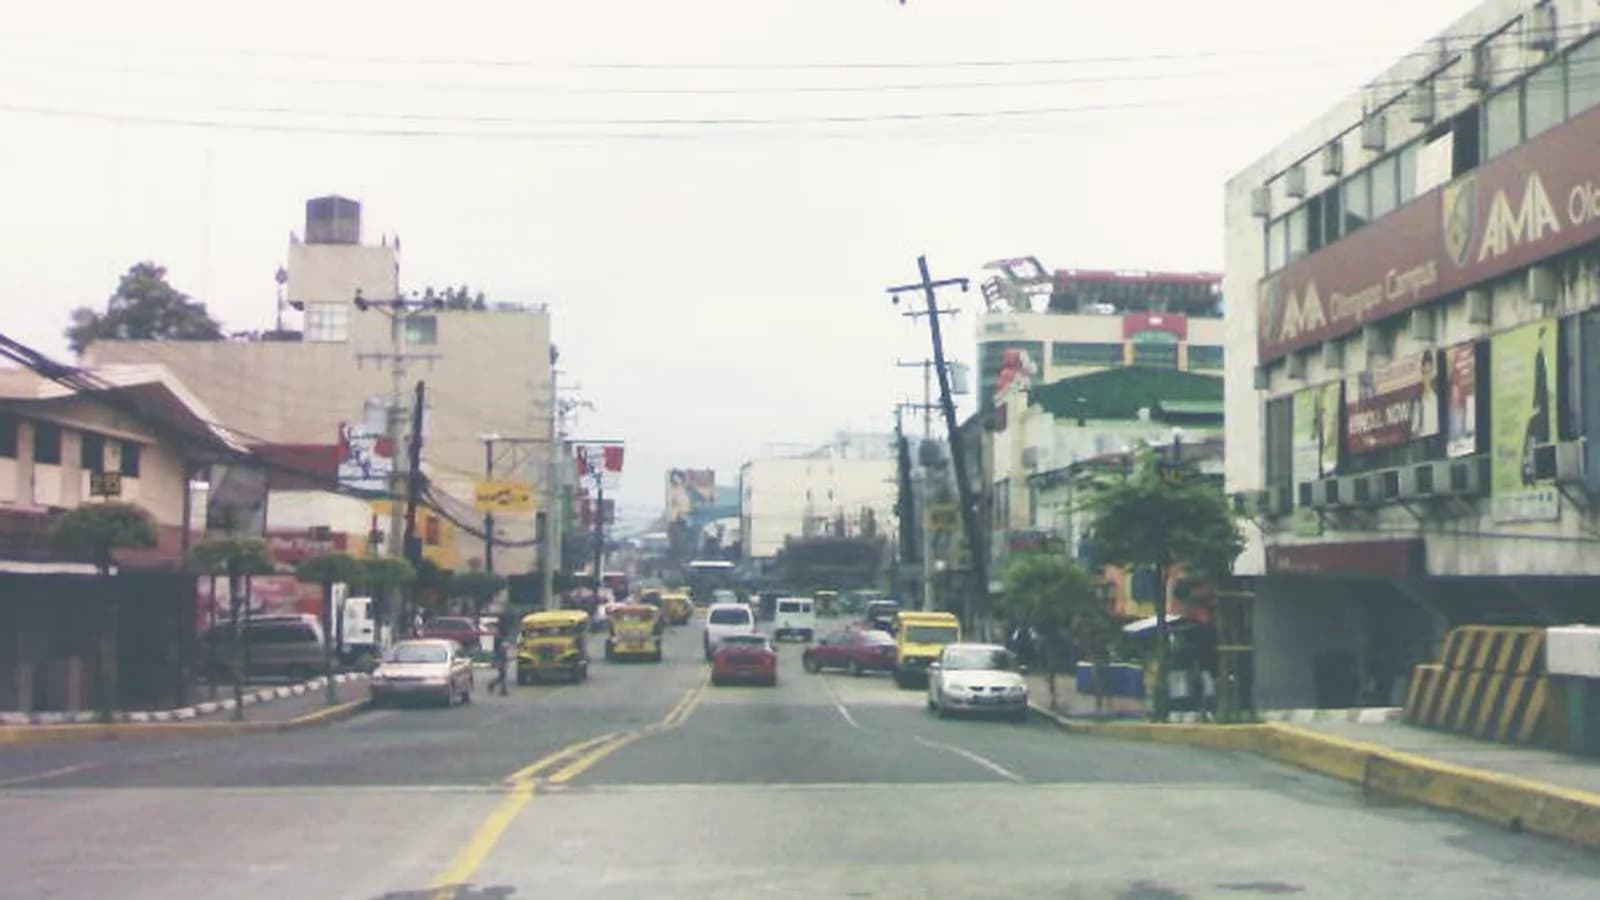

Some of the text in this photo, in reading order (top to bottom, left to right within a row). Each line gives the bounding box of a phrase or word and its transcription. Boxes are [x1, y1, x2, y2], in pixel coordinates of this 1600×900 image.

[1477, 171, 1561, 263] AMA
[1280, 279, 1327, 343] AMA
[1385, 260, 1438, 302] Campus
[1348, 400, 1410, 434] ENROLL NOW
